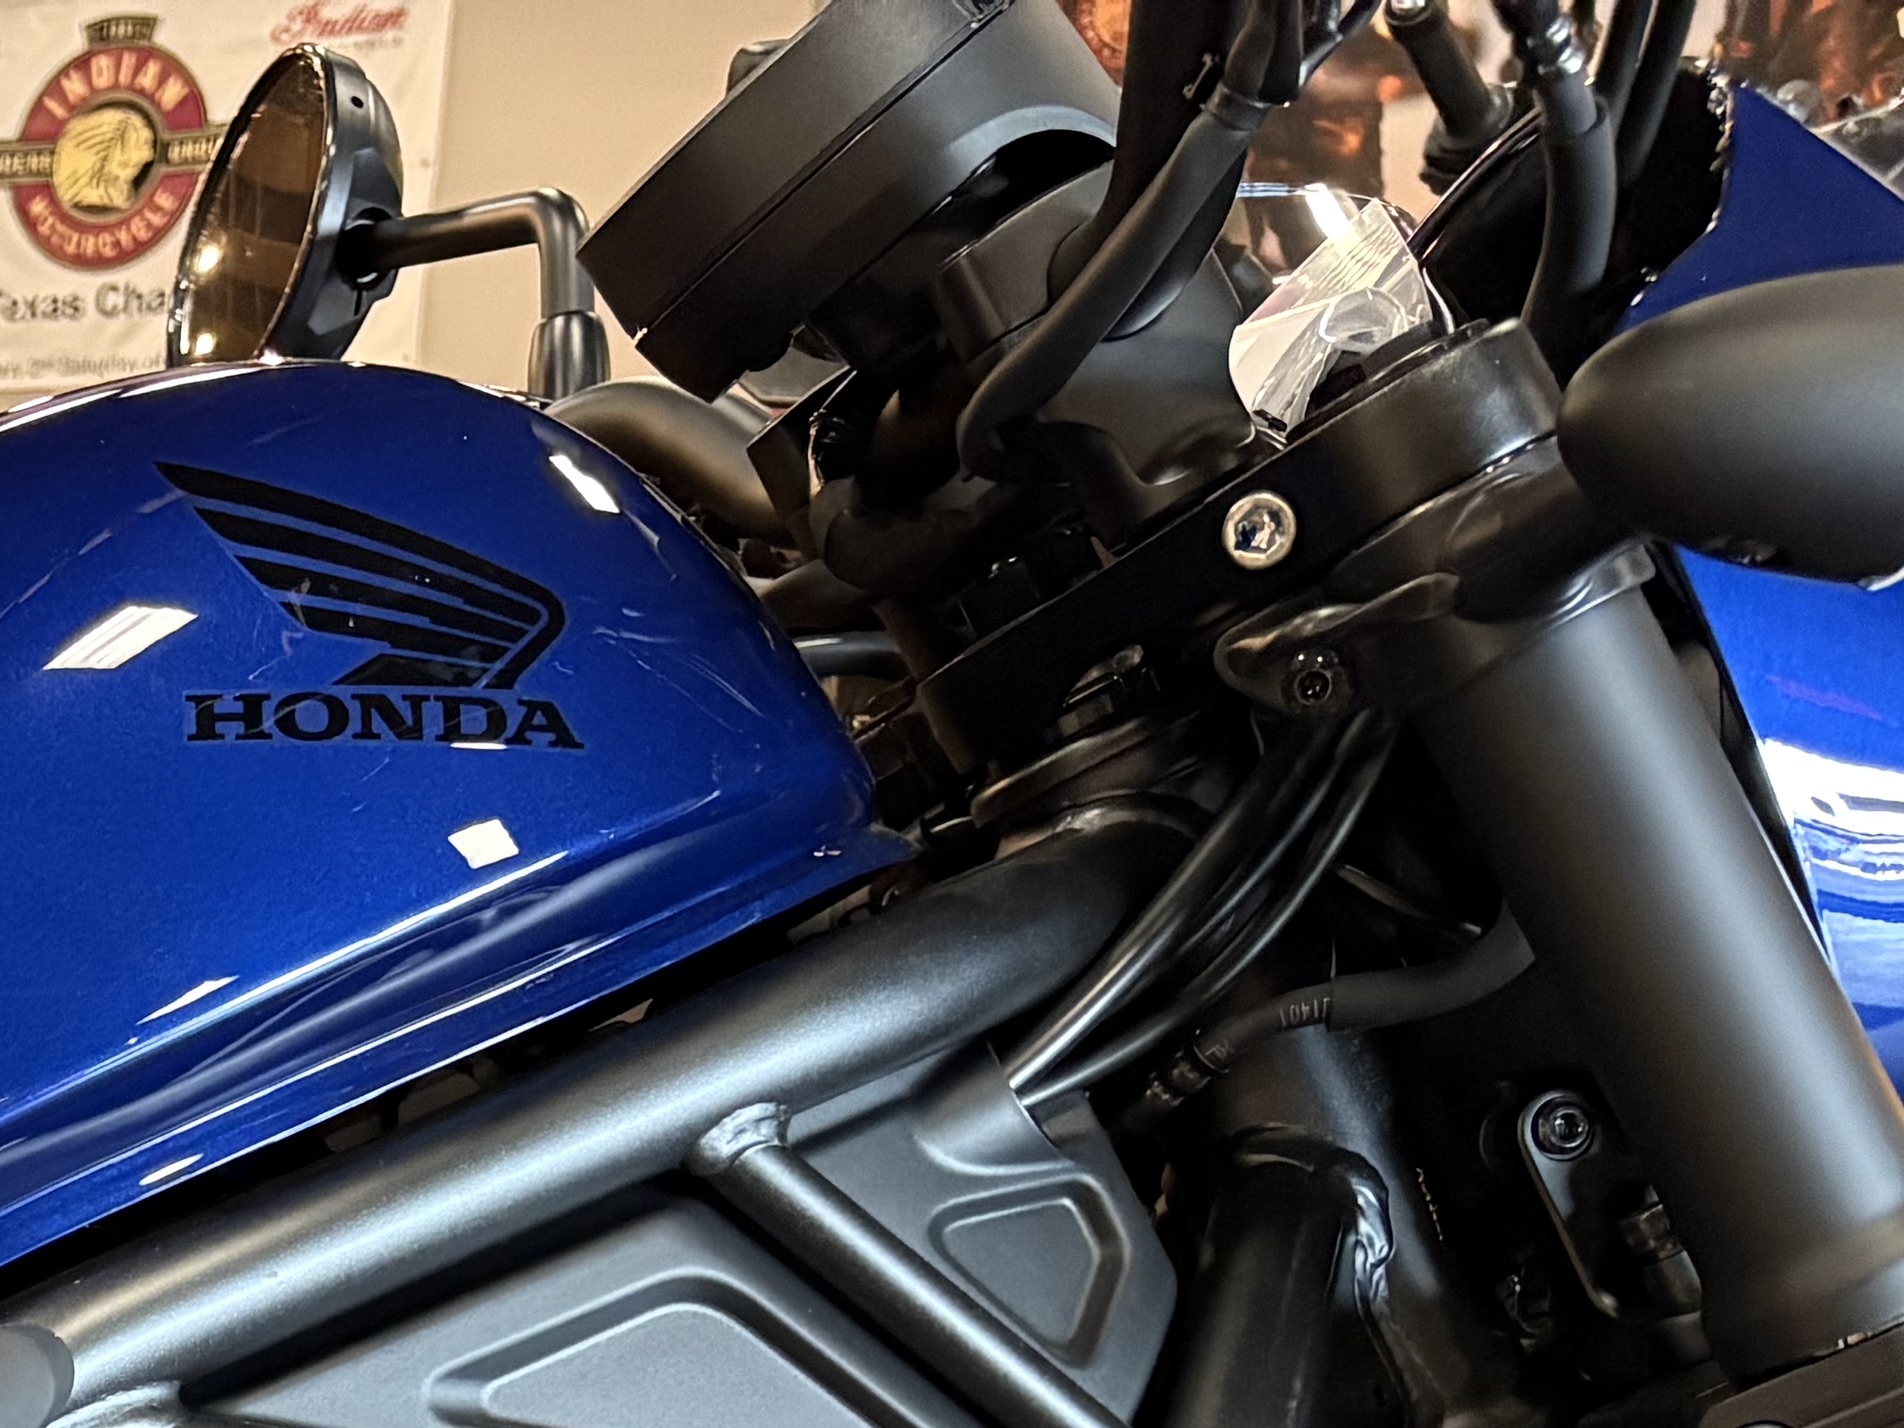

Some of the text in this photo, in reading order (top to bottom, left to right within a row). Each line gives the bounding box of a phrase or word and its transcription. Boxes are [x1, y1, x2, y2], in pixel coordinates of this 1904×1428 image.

[42, 50, 190, 120] INDIAN
[95, 281, 166, 318] Cha
[185, 692, 585, 750] HONDA
